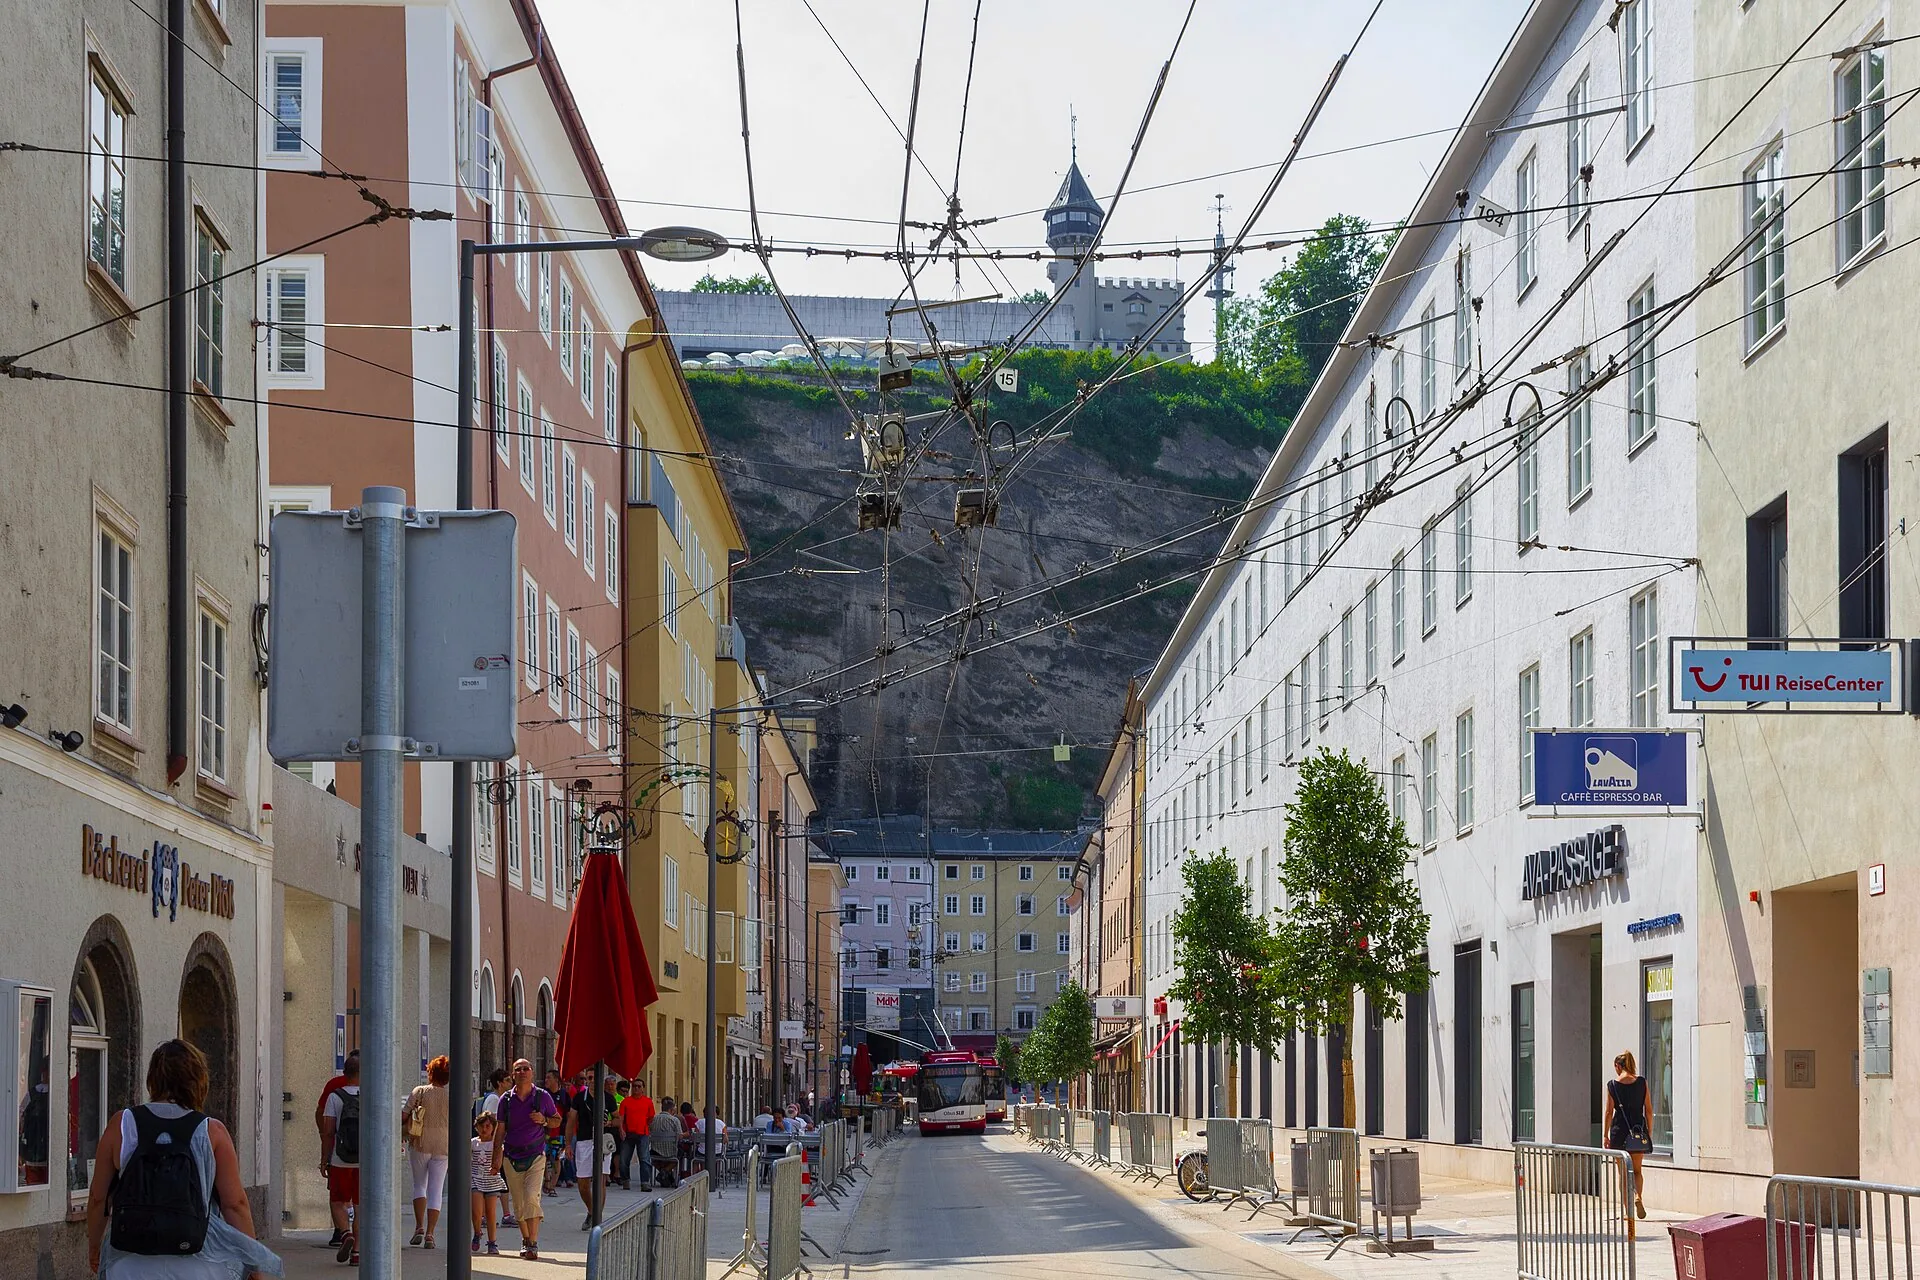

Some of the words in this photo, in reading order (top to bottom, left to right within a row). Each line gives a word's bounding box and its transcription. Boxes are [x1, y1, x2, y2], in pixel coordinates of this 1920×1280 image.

[999, 372, 1014, 386] 15
[1738, 674, 1770, 691] TUI
[1775, 674, 1885, 692] ReiseCenter
[1592, 776, 1632, 788] LAVAZZA
[1560, 791, 1590, 802] CAFFÈ
[1593, 792, 1641, 802] ESPRESSO
[1643, 792, 1662, 802] BAR
[82, 823, 149, 894] Bäckerei
[1522, 825, 1622, 901] AVA-PASSAGE
[1874, 870, 1878, 884] 1
[180, 862, 210, 913] Peter
[876, 996, 899, 1006] MdM
